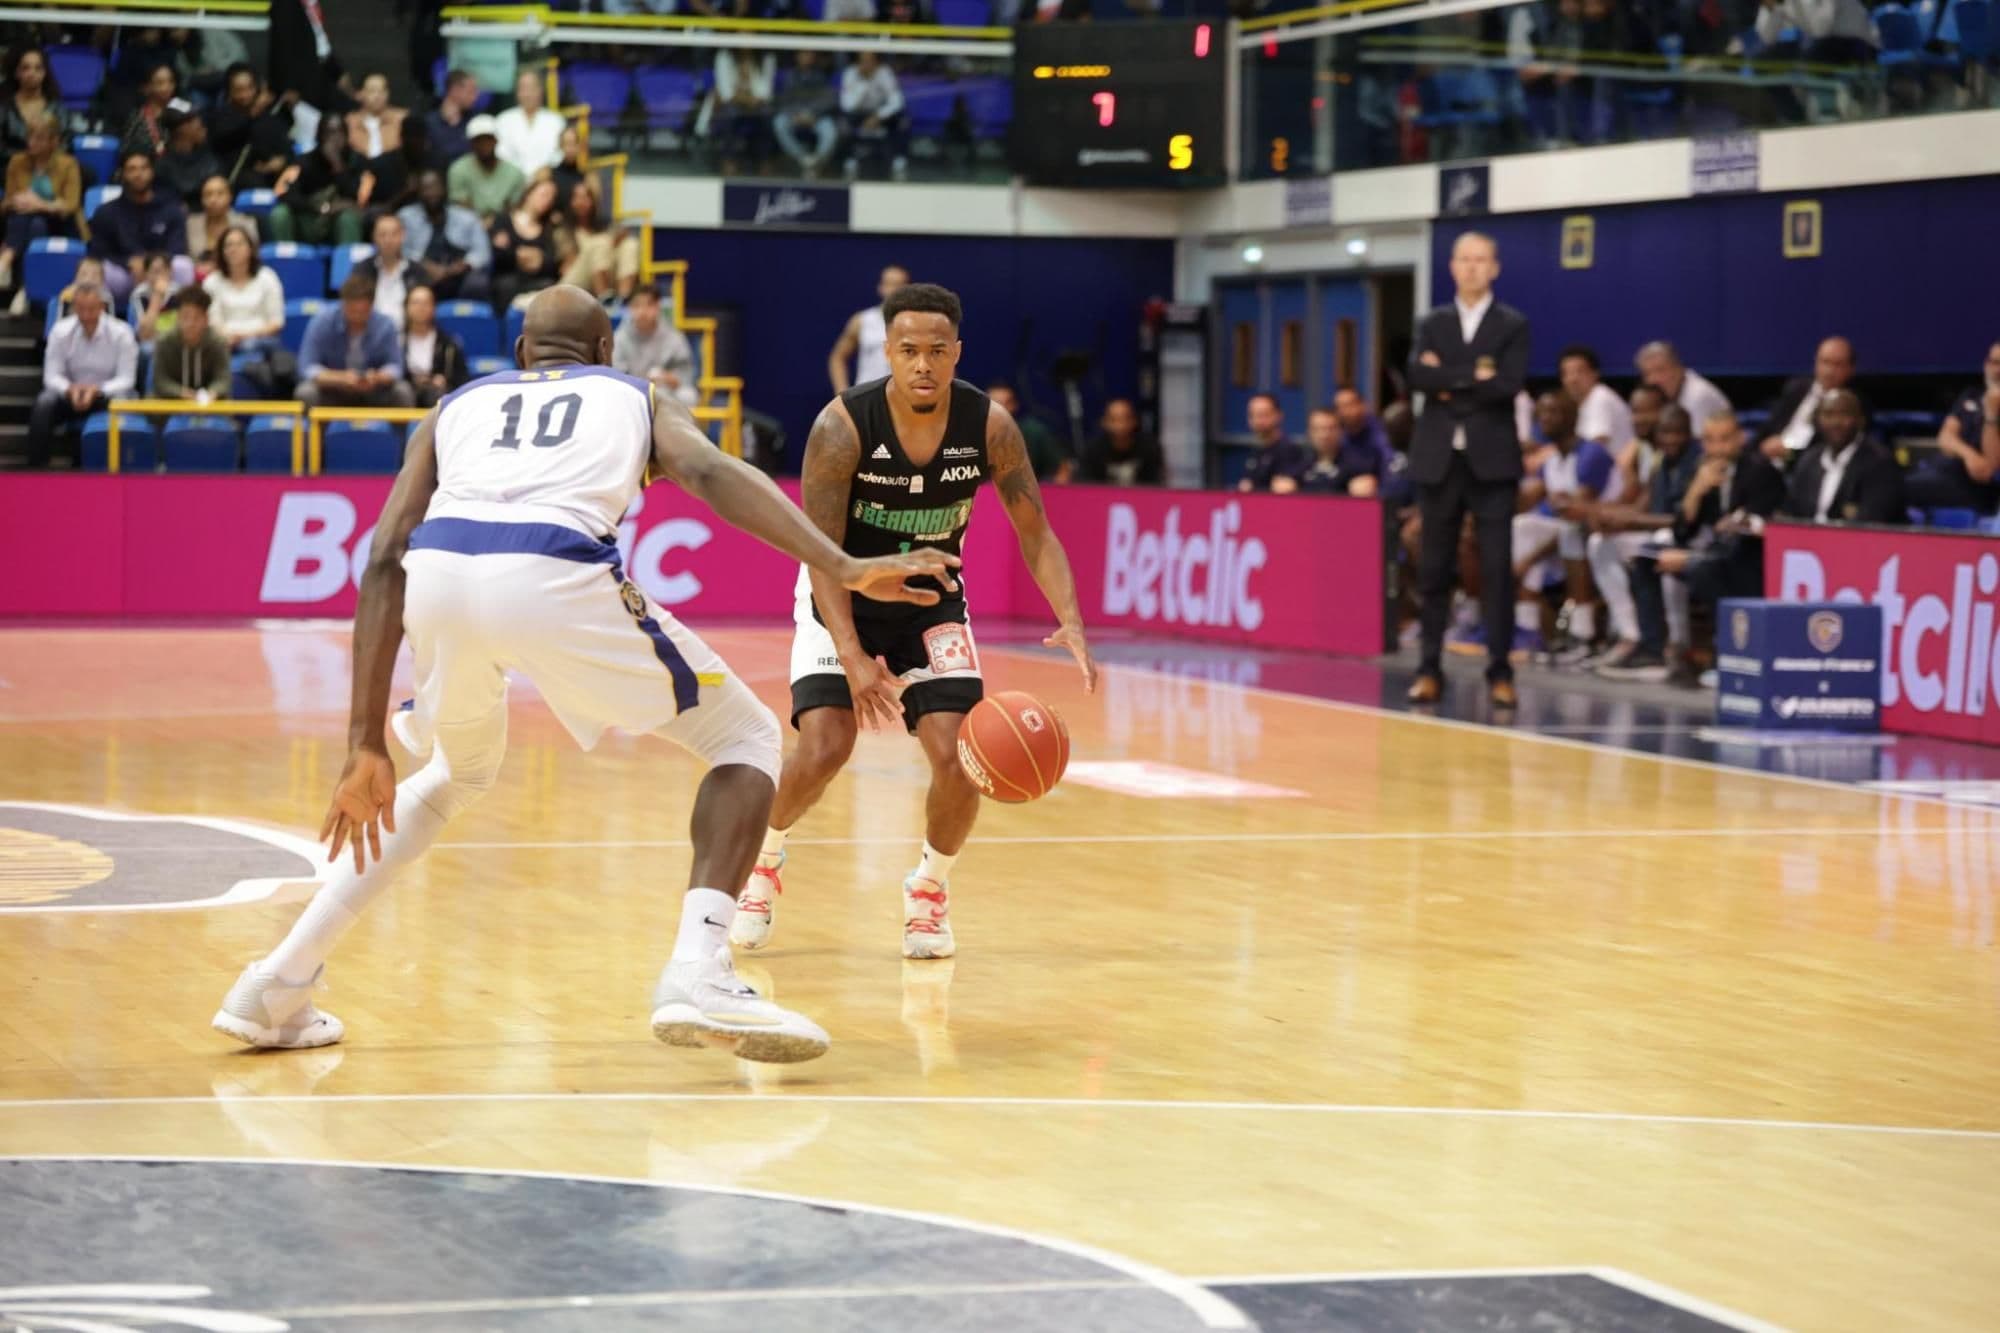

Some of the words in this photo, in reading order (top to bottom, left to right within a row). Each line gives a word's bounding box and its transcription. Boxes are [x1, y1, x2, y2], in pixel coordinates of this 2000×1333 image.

[490, 392, 584, 450] 10
[940, 465, 981, 482] AKKA
[1103, 499, 1268, 631] Betclic
